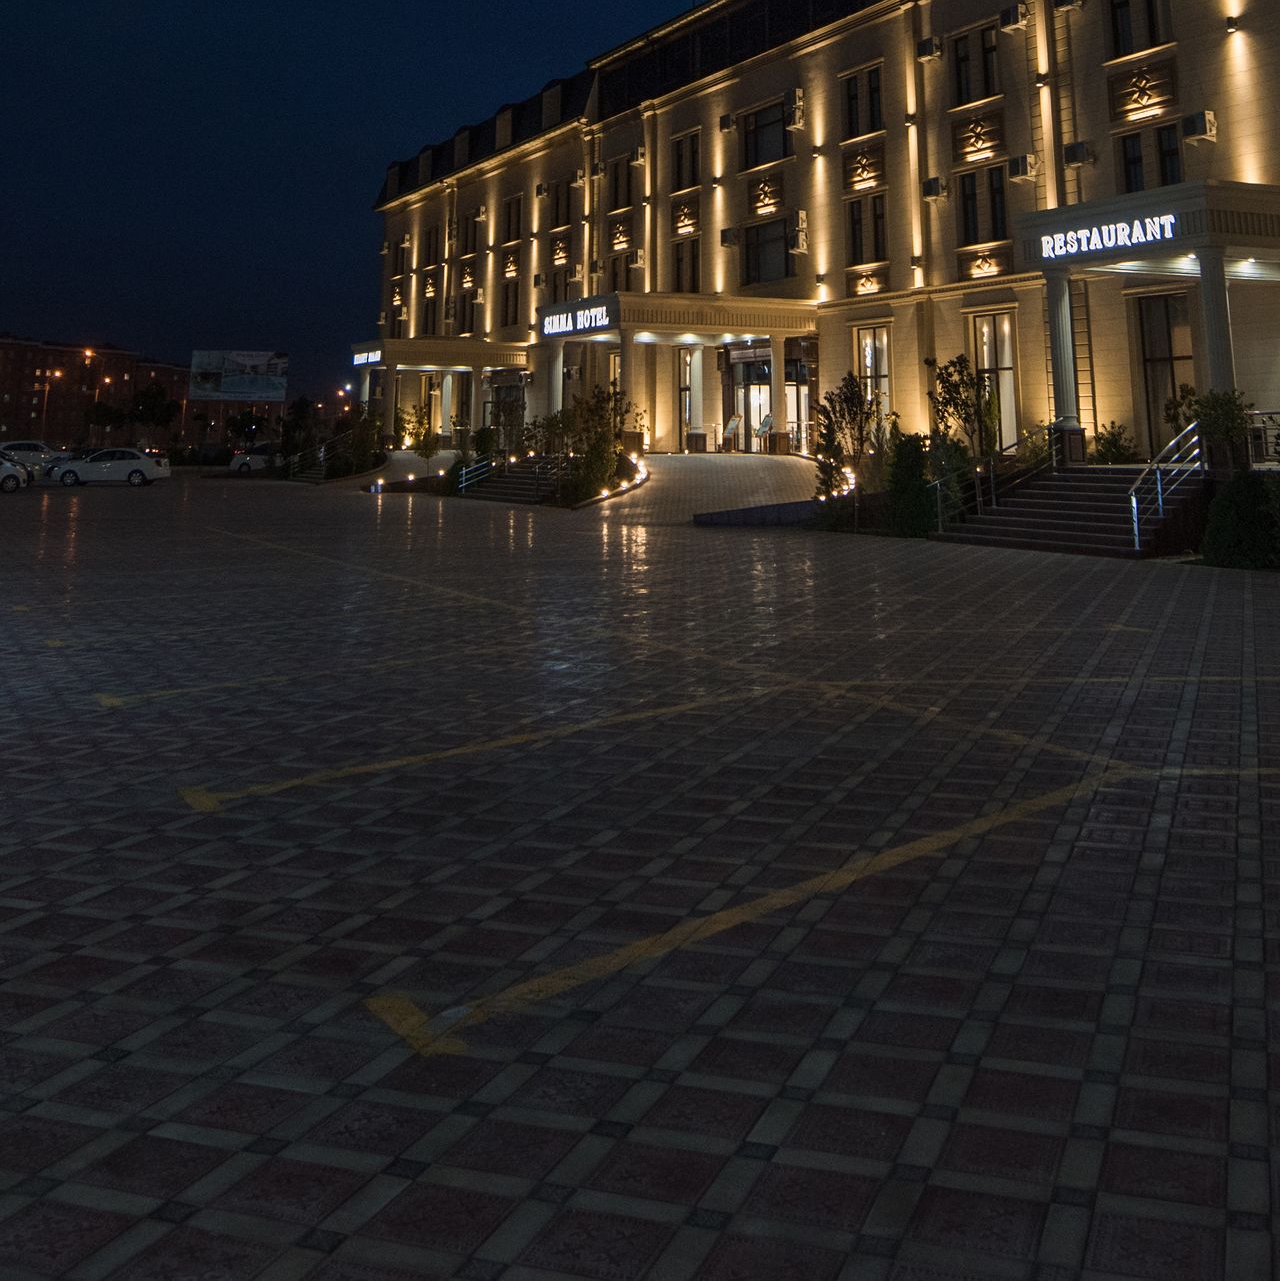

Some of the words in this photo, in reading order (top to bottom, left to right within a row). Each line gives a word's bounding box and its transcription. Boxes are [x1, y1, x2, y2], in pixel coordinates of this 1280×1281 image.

[1040, 214, 1176, 259] RESTAURANT
[543, 313, 573, 335] SIMMA
[576, 305, 610, 330] HOTEL
